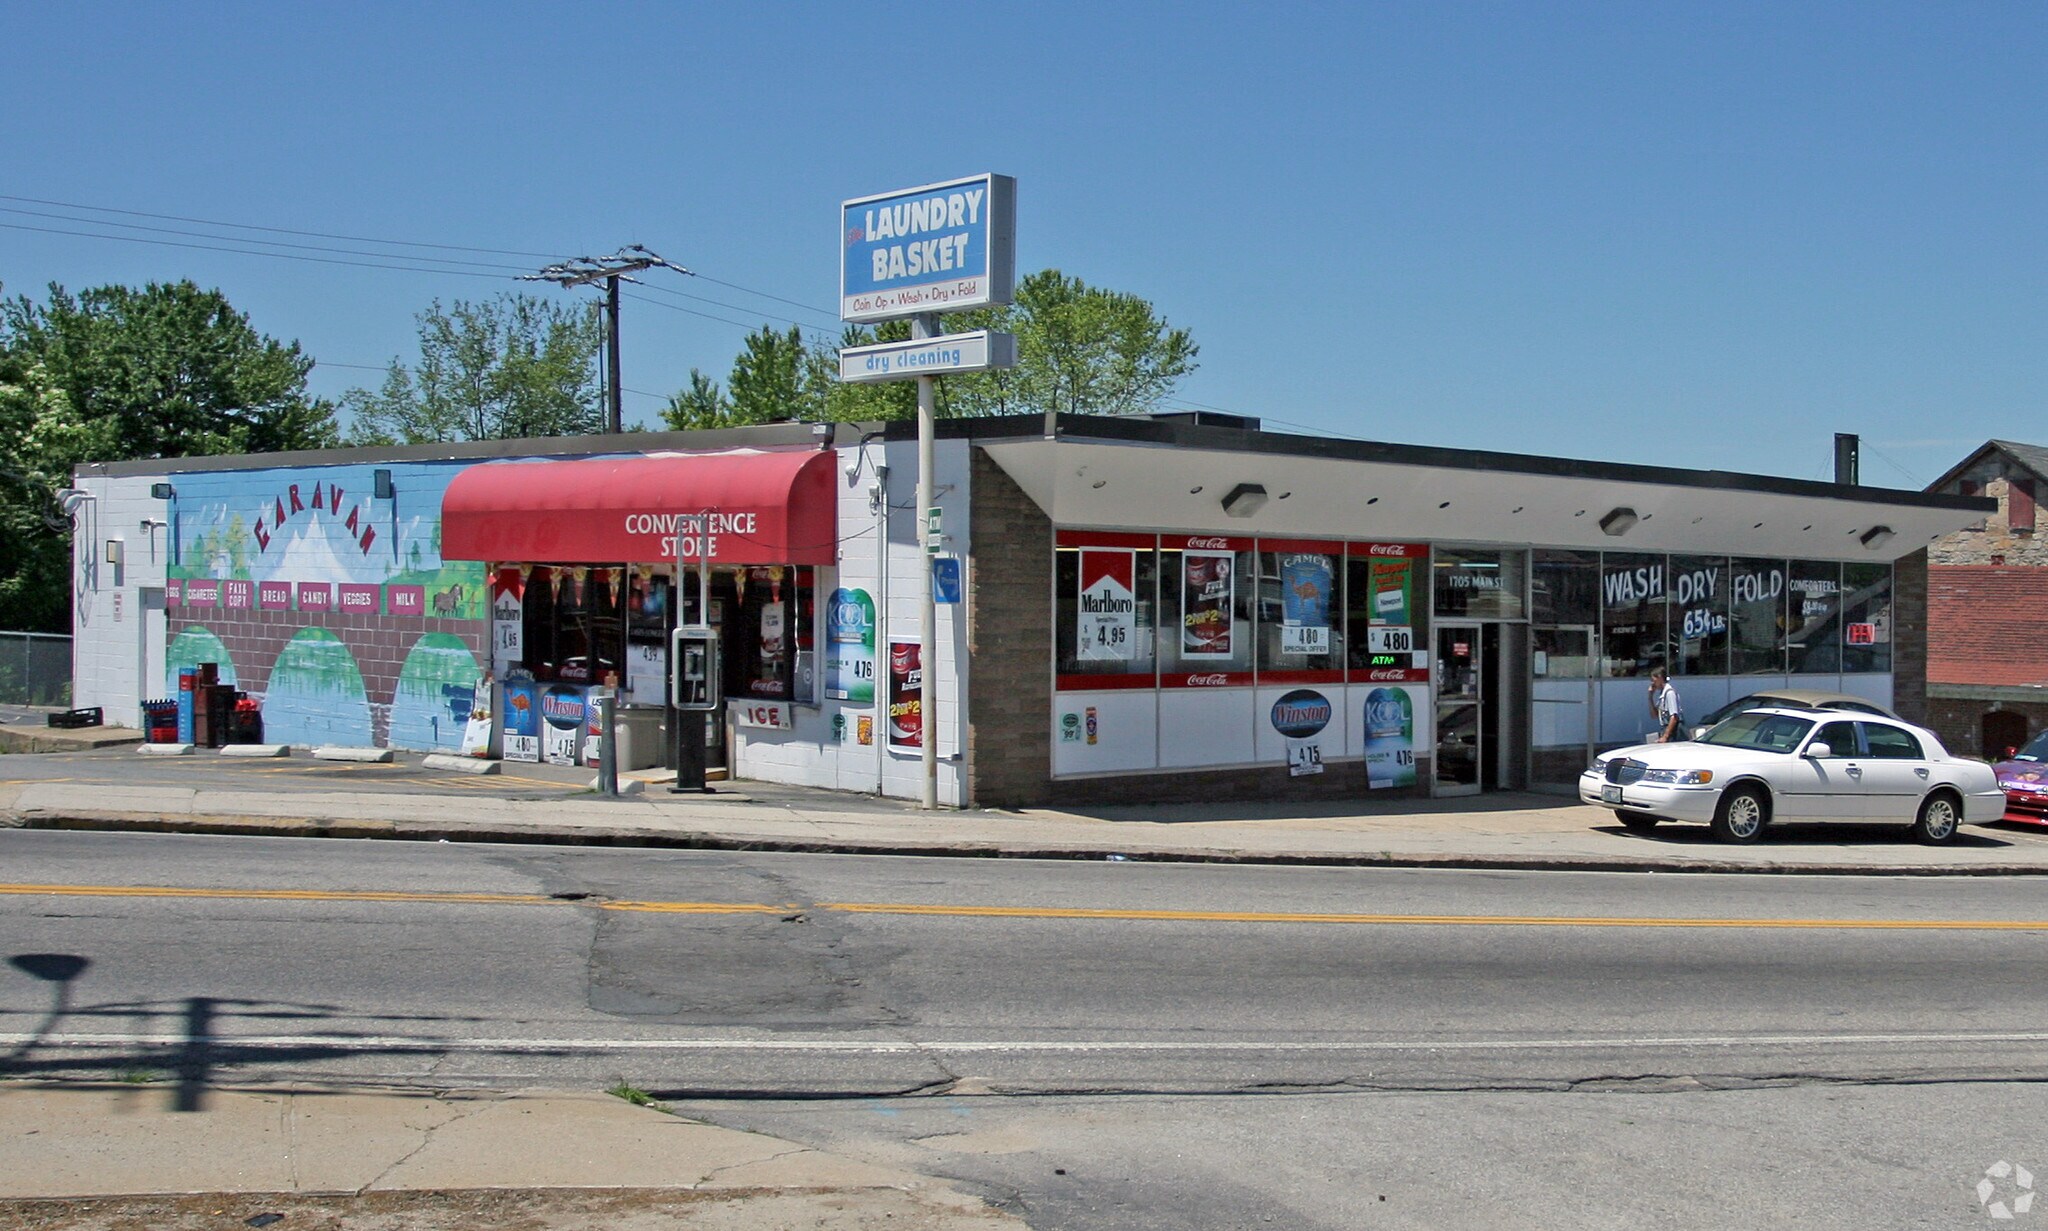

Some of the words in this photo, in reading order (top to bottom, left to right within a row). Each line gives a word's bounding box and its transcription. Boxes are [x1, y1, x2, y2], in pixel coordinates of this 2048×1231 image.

[865, 188, 984, 242] LAUNDRY
[872, 232, 969, 282] BASKET
[853, 297, 871, 312] Coin
[875, 295, 888, 311] Op
[898, 290, 922, 306] Wash
[932, 287, 949, 302] Dry
[957, 281, 977, 297] Fold
[866, 353, 890, 373] dry
[897, 347, 961, 367] cleaning
[254, 480, 376, 557] CARAVAN
[1284, 554, 1330, 569] CAMEL
[1449, 575, 1469, 588] 1705
[1472, 576, 1493, 588] MAIN
[1605, 564, 1662, 604] WASH
[1678, 567, 1718, 605] DRY
[1734, 569, 1783, 605] FOLD
[1790, 579, 1837, 593] COMFORTERS
[229, 594, 246, 607] COPY
[262, 590, 287, 603] BREAD
[303, 591, 328, 605] CANDY
[343, 592, 372, 606] VEGGIES
[396, 592, 416, 606] MILK
[1081, 589, 1132, 613] Marlboro
[828, 603, 873, 628] KOOL
[1383, 632, 1410, 650] 480
[1371, 656, 1395, 665] ATM
[505, 667, 536, 682] CAMEL
[543, 695, 584, 717] Winston
[1275, 703, 1329, 723] Winston
[1366, 701, 1411, 724] KOOL
[748, 708, 781, 726] ICE
